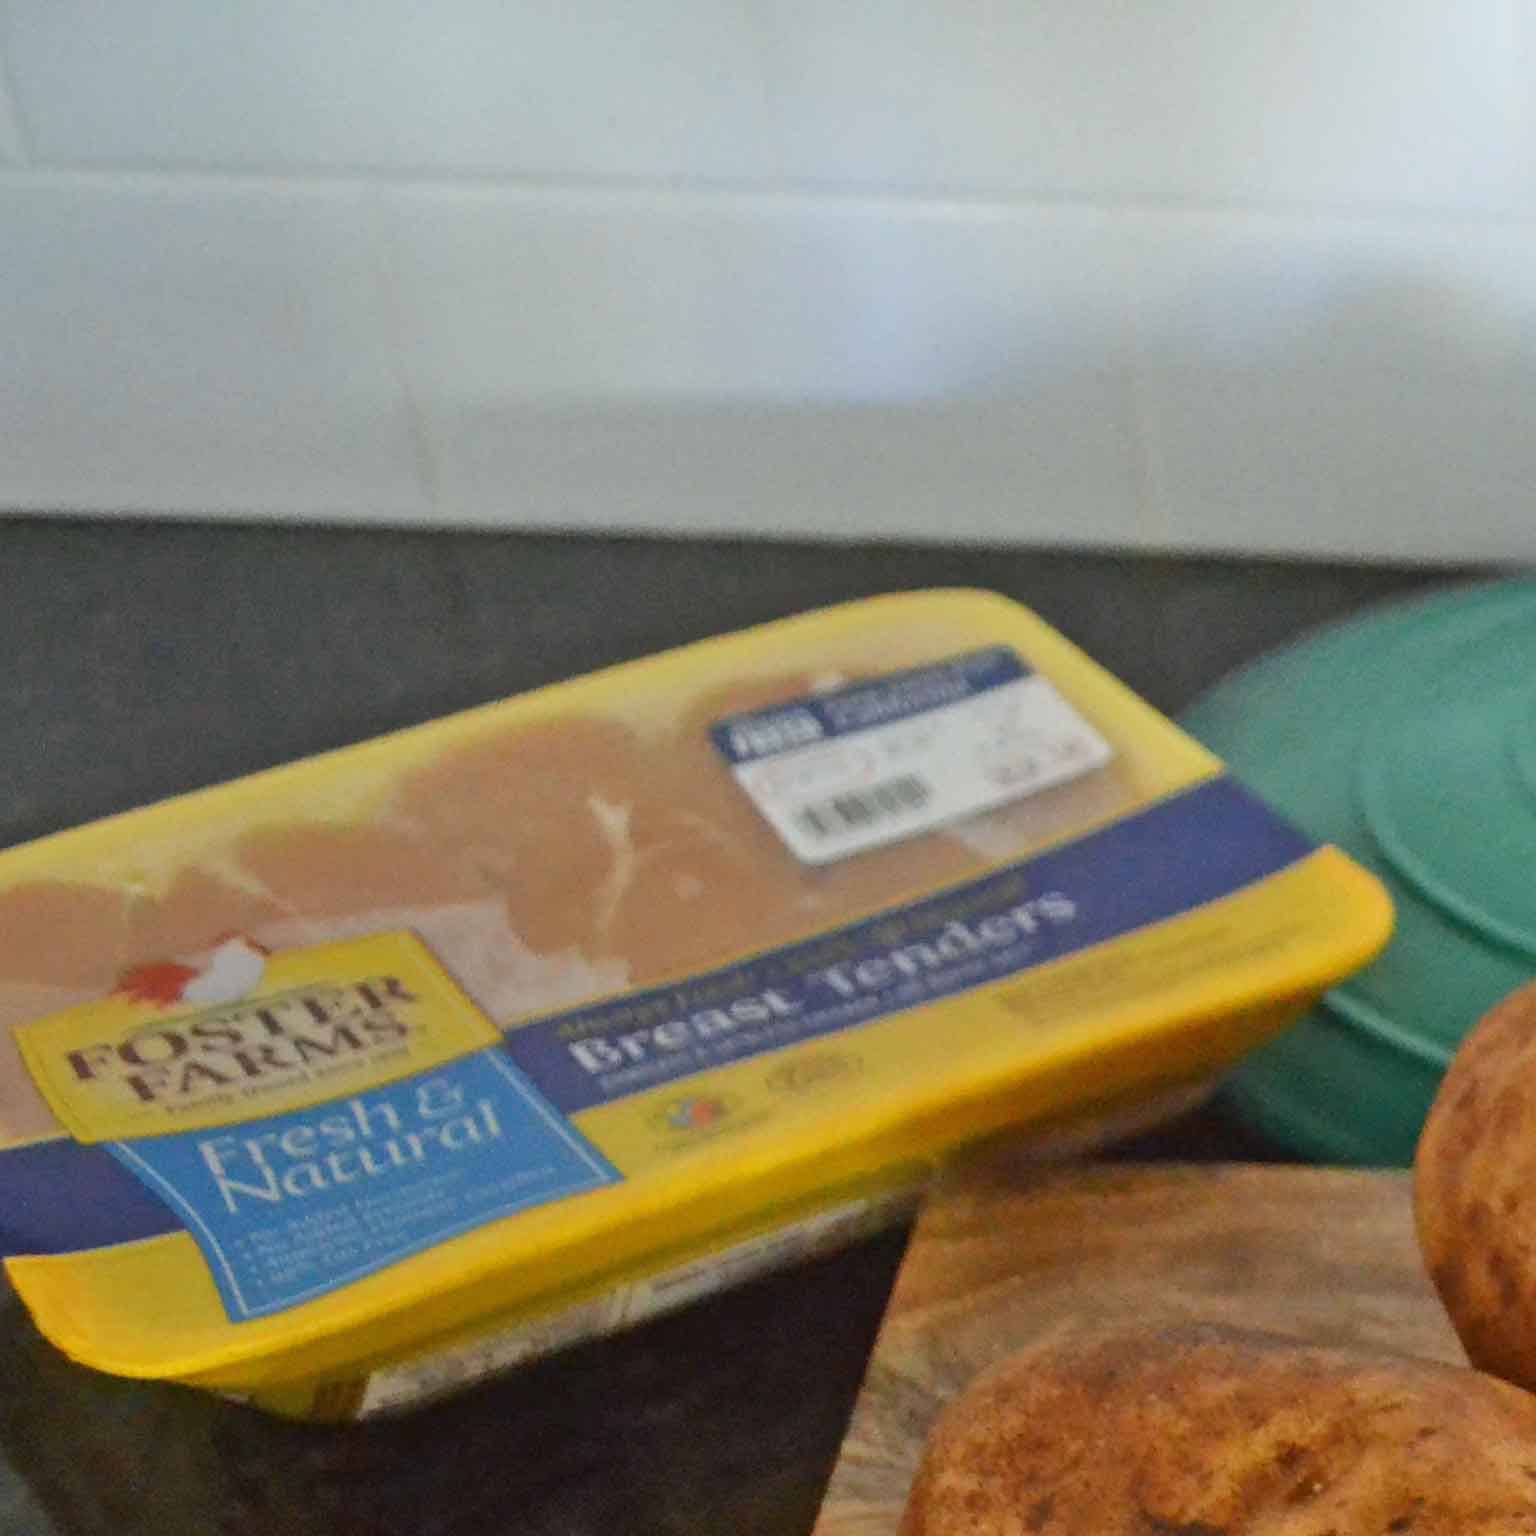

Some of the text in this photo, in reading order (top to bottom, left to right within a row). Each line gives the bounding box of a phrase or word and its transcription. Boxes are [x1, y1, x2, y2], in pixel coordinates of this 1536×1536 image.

[66, 976, 418, 1080] FOSTER
[569, 988, 792, 1074] Breast
[815, 890, 1076, 995] Tenders
[124, 1014, 411, 1102] FARMS
[200, 1100, 400, 1176] Fresh
[416, 1078, 464, 1120] &
[213, 1098, 502, 1214] Natural
